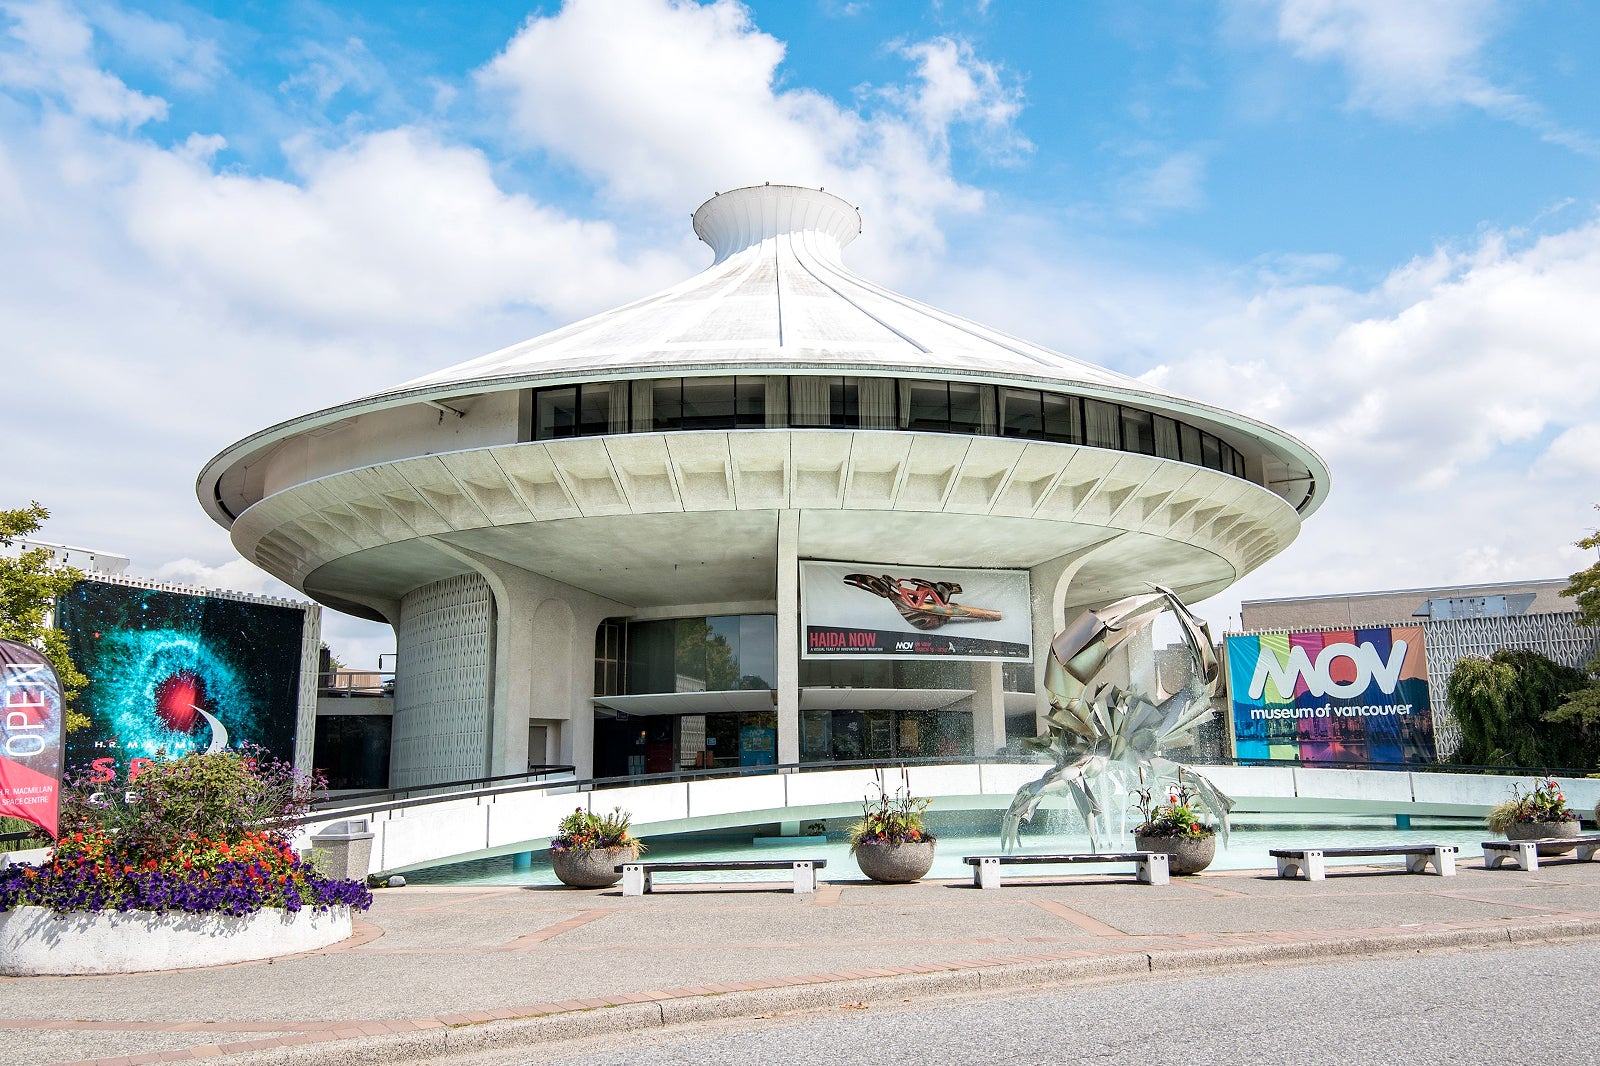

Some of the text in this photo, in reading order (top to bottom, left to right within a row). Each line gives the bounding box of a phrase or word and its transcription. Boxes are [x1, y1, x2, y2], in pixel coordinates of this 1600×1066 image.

[810, 632, 876, 647] HAIDA NOW
[895, 641, 914, 650] MOV
[1248, 640, 1408, 700] MOV
[6, 663, 46, 757] OPEN
[1250, 703, 1412, 720] museum of vancouver
[94, 741, 121, 749] H.R.
[13, 785, 53, 796] MACMILLAN
[2, 796, 49, 806] SPACE CENTRE
